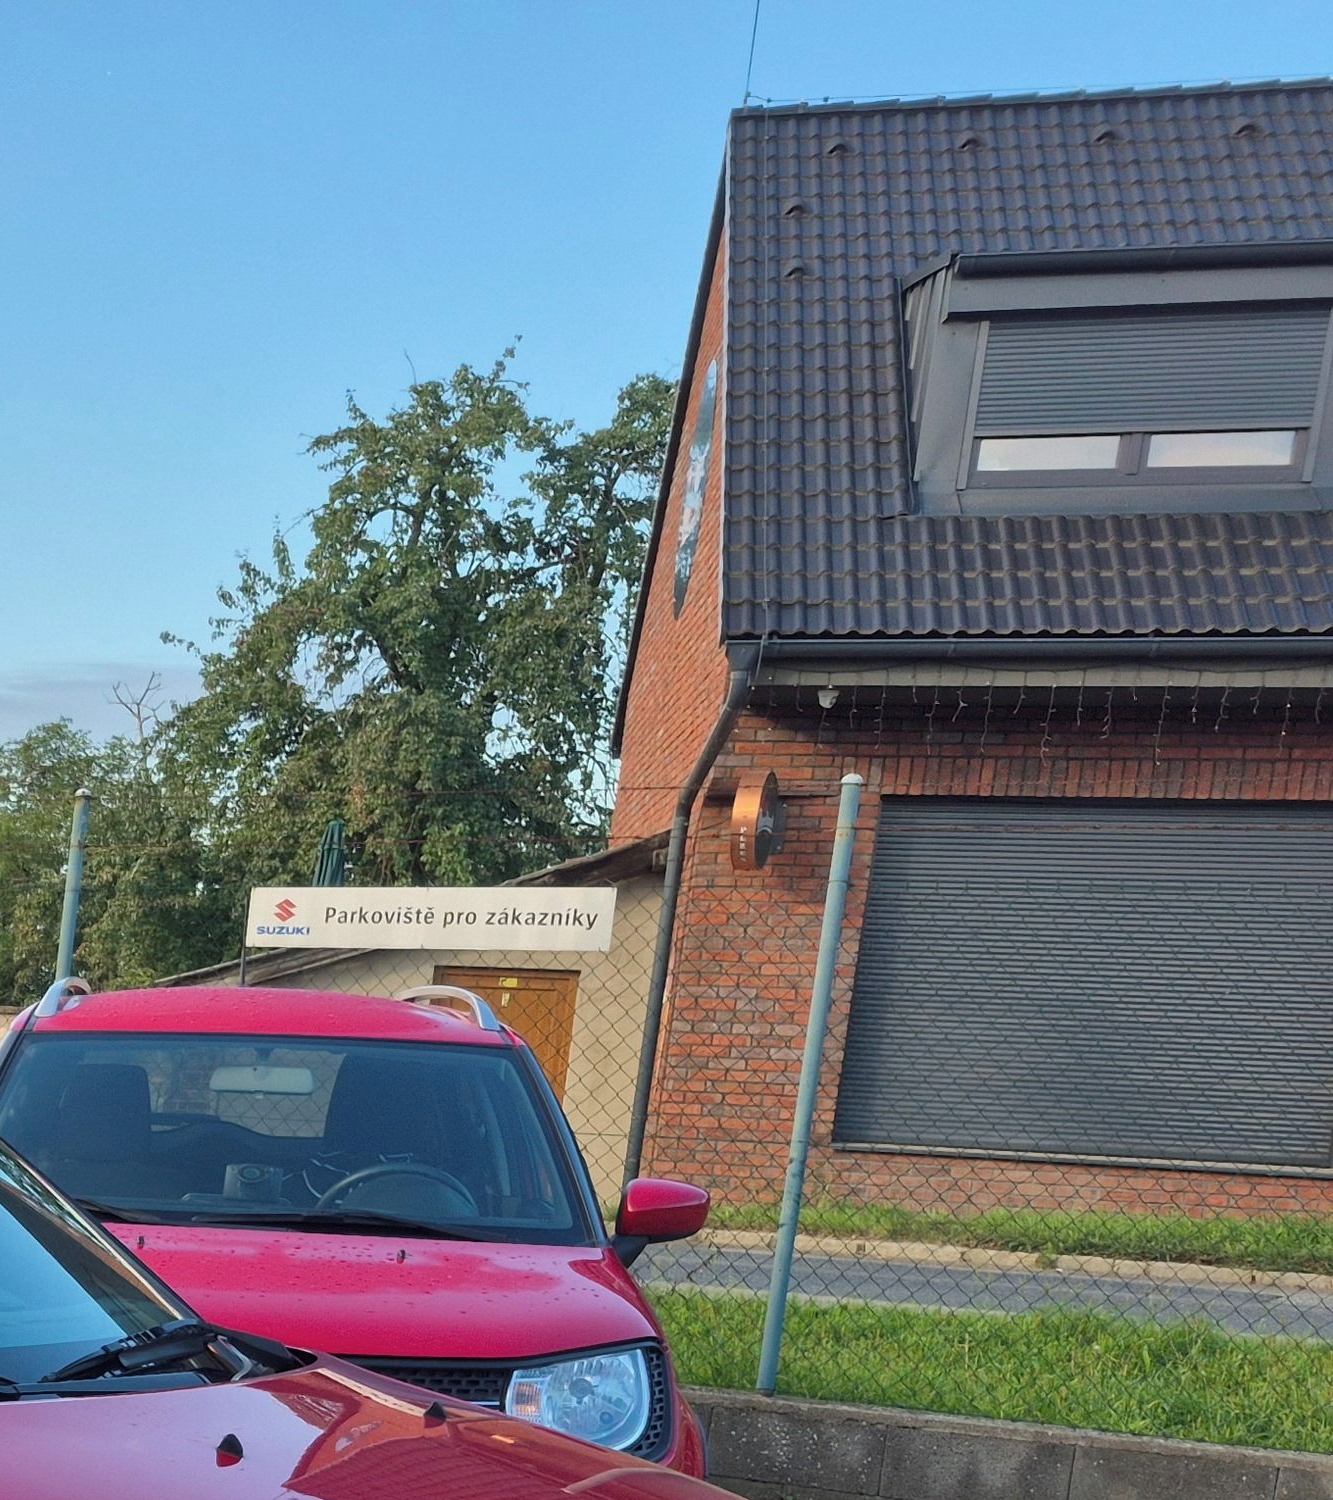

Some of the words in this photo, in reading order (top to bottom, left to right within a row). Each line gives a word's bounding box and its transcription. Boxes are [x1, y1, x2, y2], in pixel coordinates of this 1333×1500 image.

[324, 906, 435, 925] Parkoviště
[442, 909, 478, 928] pro
[485, 906, 599, 930] zákazníky
[256, 926, 310, 935] SUZUKI
